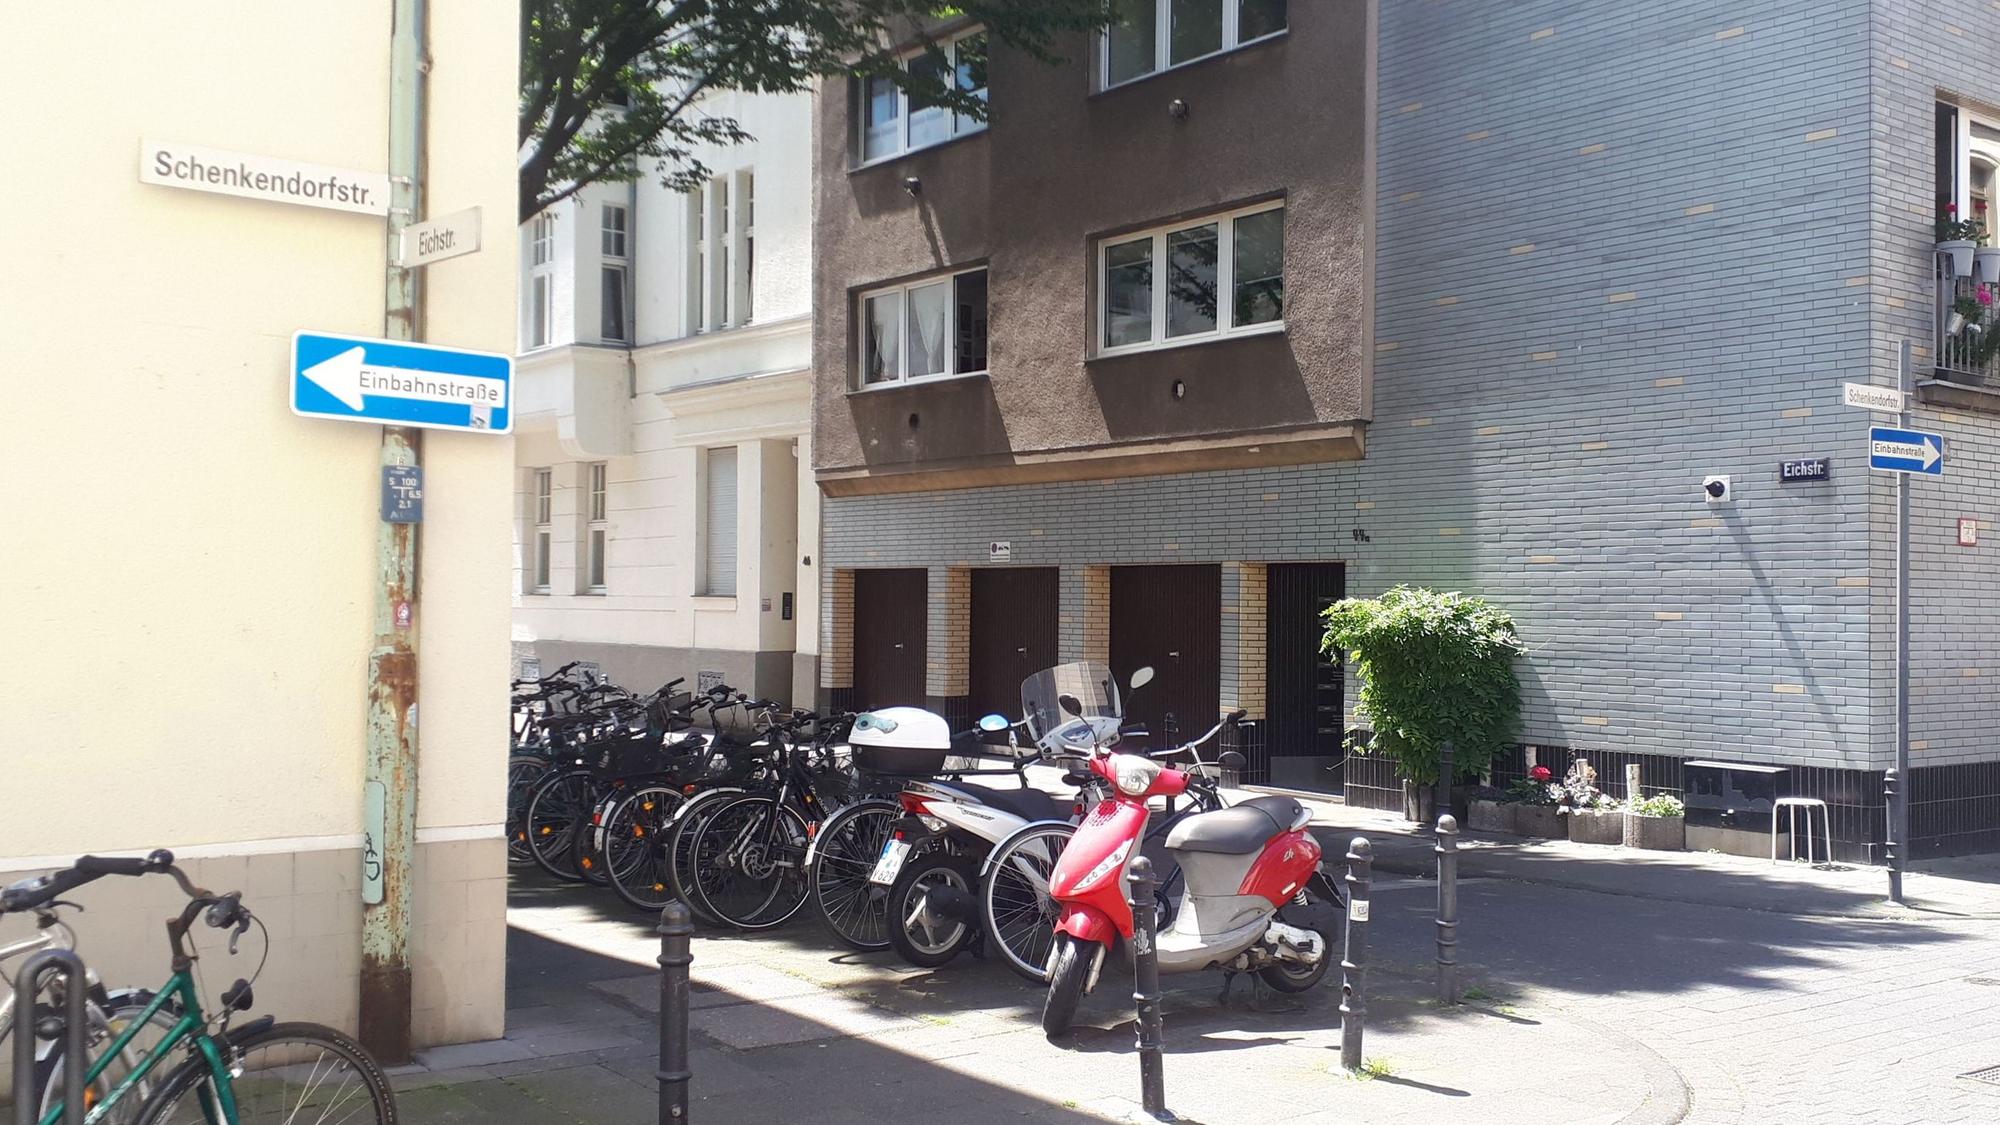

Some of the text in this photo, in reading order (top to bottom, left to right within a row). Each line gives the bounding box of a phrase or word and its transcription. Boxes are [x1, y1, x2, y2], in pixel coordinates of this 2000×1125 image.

[155, 150, 375, 206] Schenkendorfstr.
[418, 229, 456, 256] Eichstr.
[359, 370, 499, 401] Einbahnstraße
[1849, 388, 1900, 408] Schenkendorfstr.
[1874, 443, 1925, 458] Einbahnstraße
[1783, 461, 1824, 477] Eichstr.
